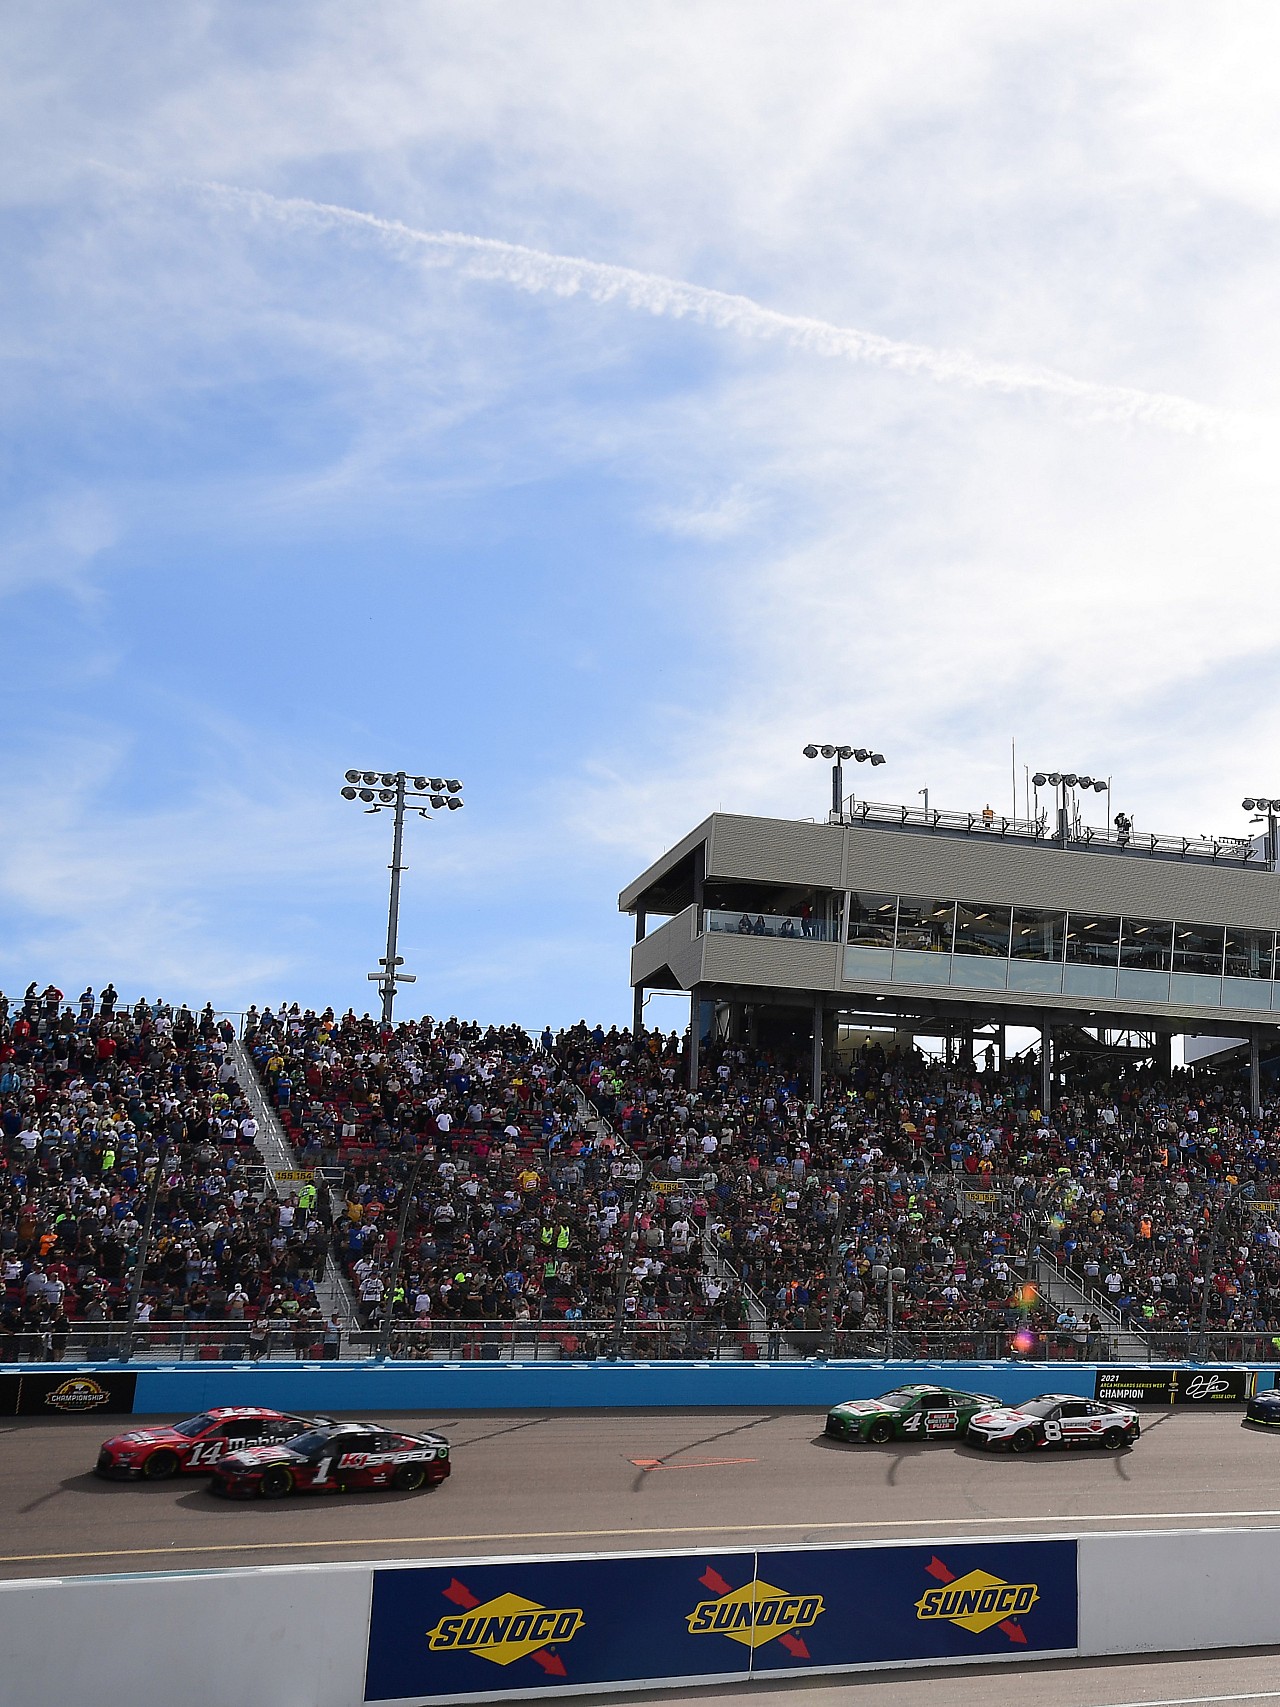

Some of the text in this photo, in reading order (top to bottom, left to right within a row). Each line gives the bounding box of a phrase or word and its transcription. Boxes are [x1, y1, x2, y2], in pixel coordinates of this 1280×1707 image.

[51, 1394, 104, 1402] CHAMPIONSHIP
[1099, 1389, 1144, 1399] CHAMPION
[903, 1412, 922, 1432] 4
[1044, 1421, 1062, 1441] 8
[186, 1441, 225, 1467] 14
[311, 1456, 333, 1484] 1
[692, 1599, 819, 1630] SUNOCO
[921, 1588, 1037, 1615] SUNOCO
[433, 1612, 579, 1647] SUNOCO
